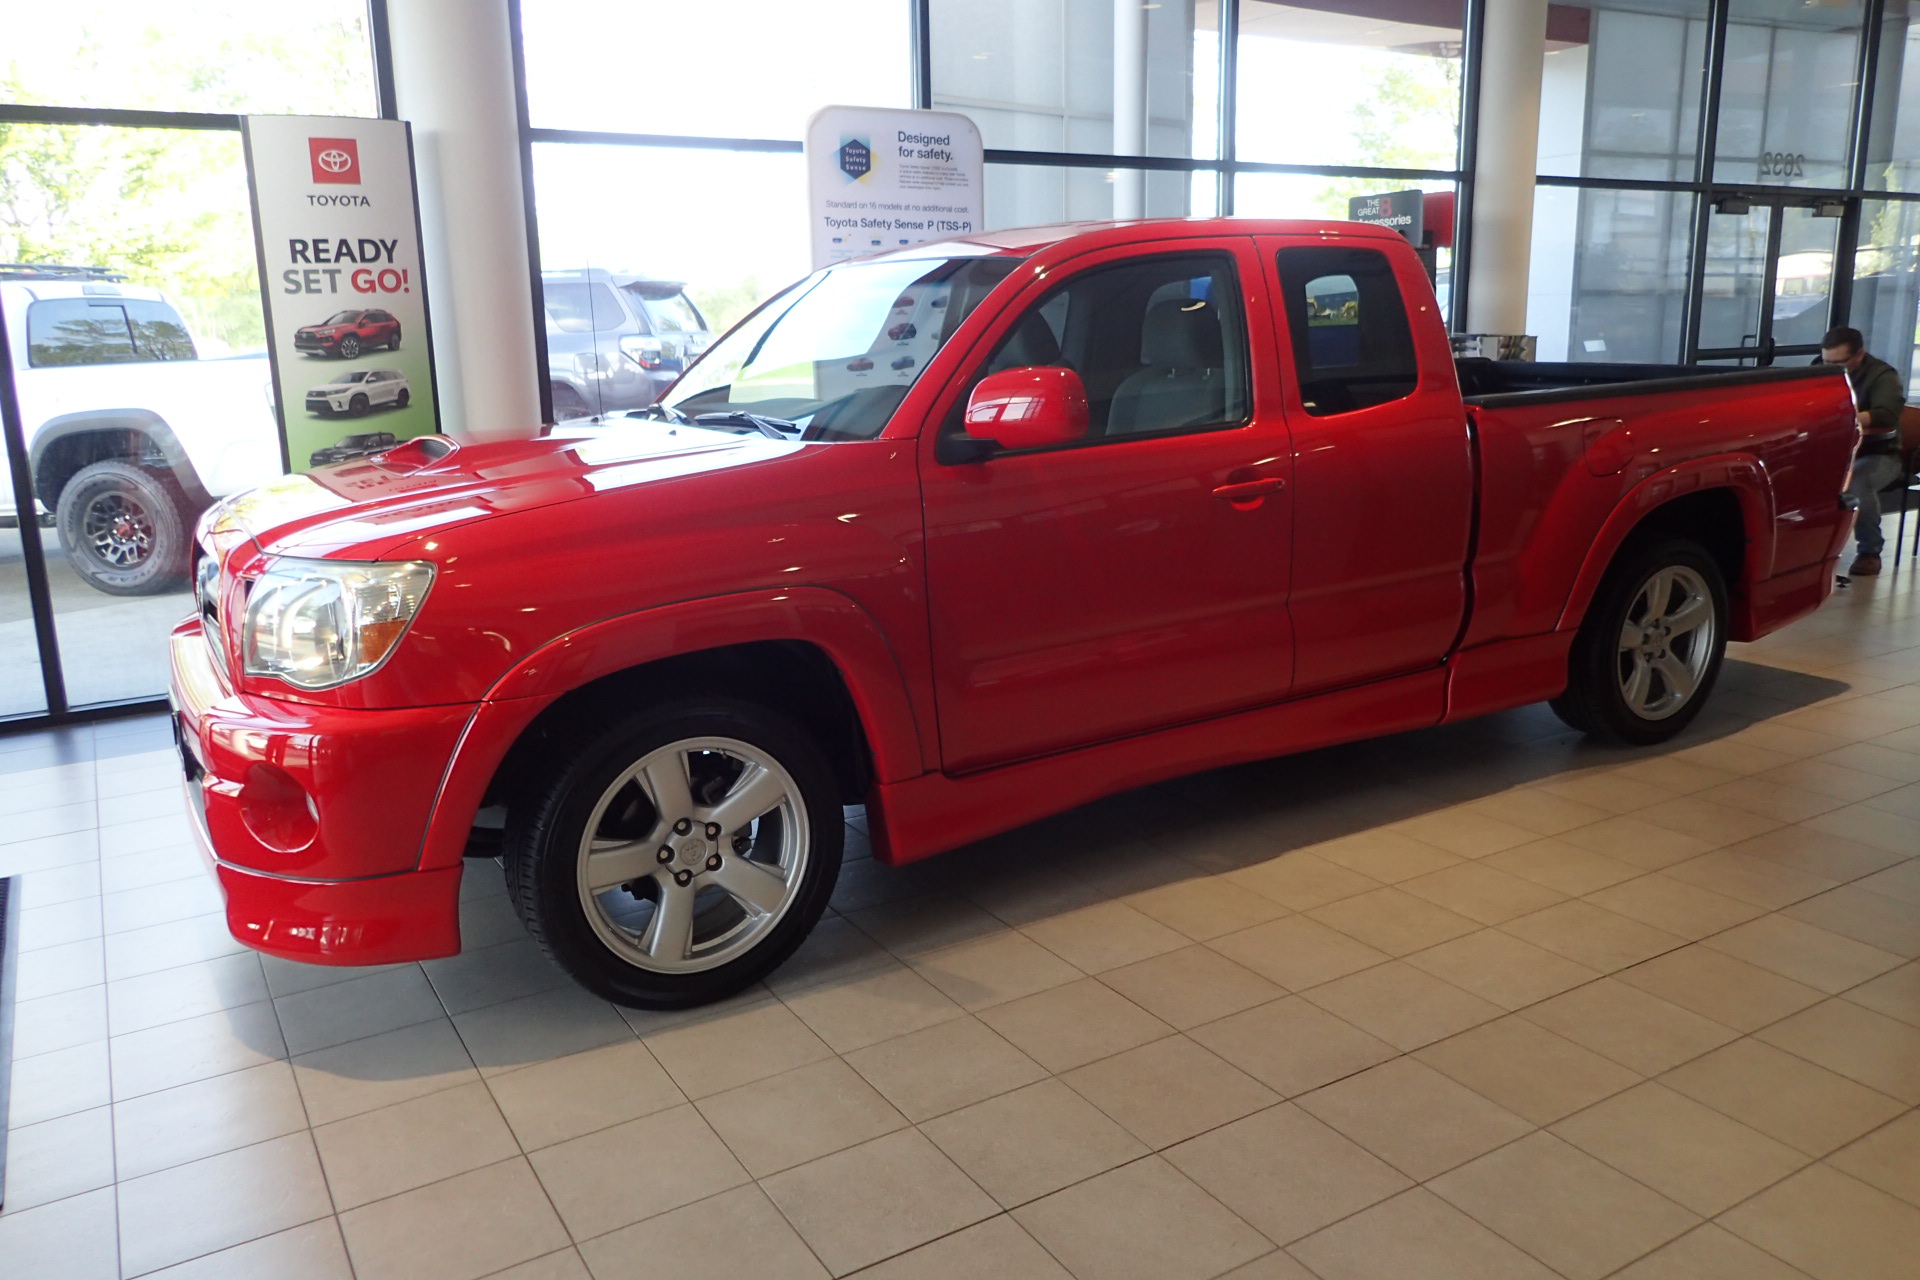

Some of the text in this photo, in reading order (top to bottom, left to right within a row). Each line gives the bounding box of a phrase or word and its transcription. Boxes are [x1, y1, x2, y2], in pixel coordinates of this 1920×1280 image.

[898, 130, 950, 147] Designed
[845, 147, 866, 155] Toyota
[898, 146, 953, 163] for safety.
[845, 155, 866, 165] Safety
[307, 195, 370, 207] TOYOTA
[825, 200, 858, 209] Standard
[878, 203, 903, 211] models
[922, 204, 953, 213] additional
[1357, 196, 1393, 217] GREAT 8
[1366, 199, 1380, 207] THE
[823, 216, 972, 234] Toyota Safety Sense P (TSS-P)
[289, 238, 399, 264] READY
[283, 269, 410, 295] SET GO!
